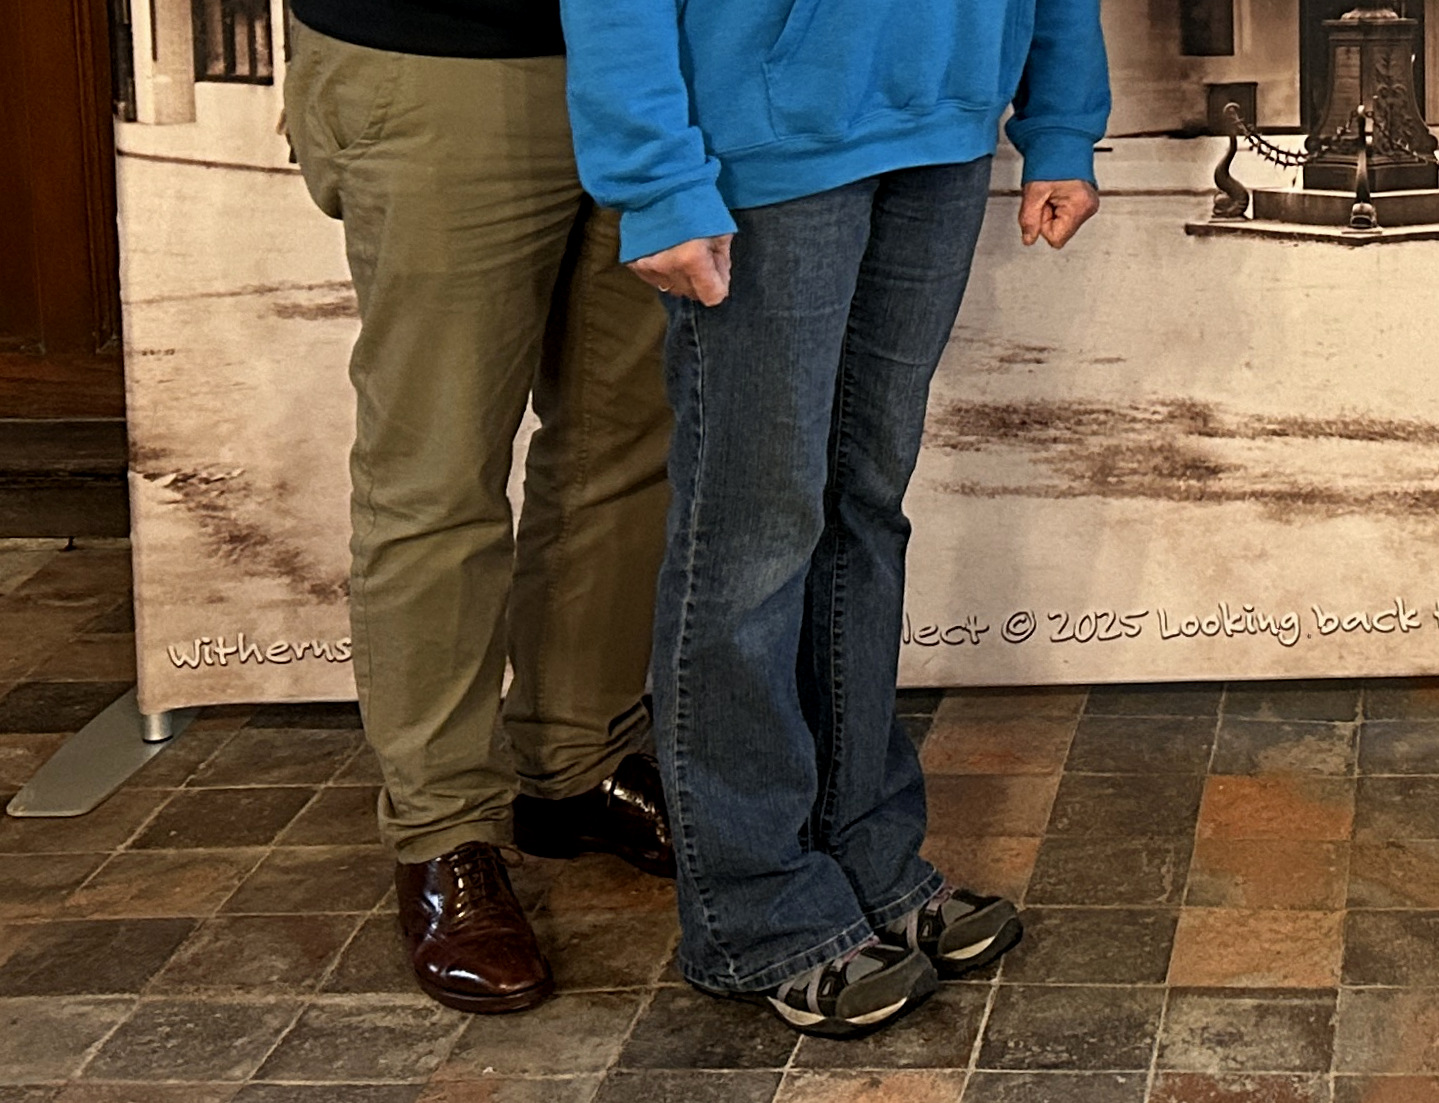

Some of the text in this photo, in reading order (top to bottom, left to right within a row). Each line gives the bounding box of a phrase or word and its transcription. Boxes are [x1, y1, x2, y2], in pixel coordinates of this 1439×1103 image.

[1048, 609, 1150, 644] 2025
[1157, 600, 1301, 647] Looking
[1312, 597, 1421, 635] back
